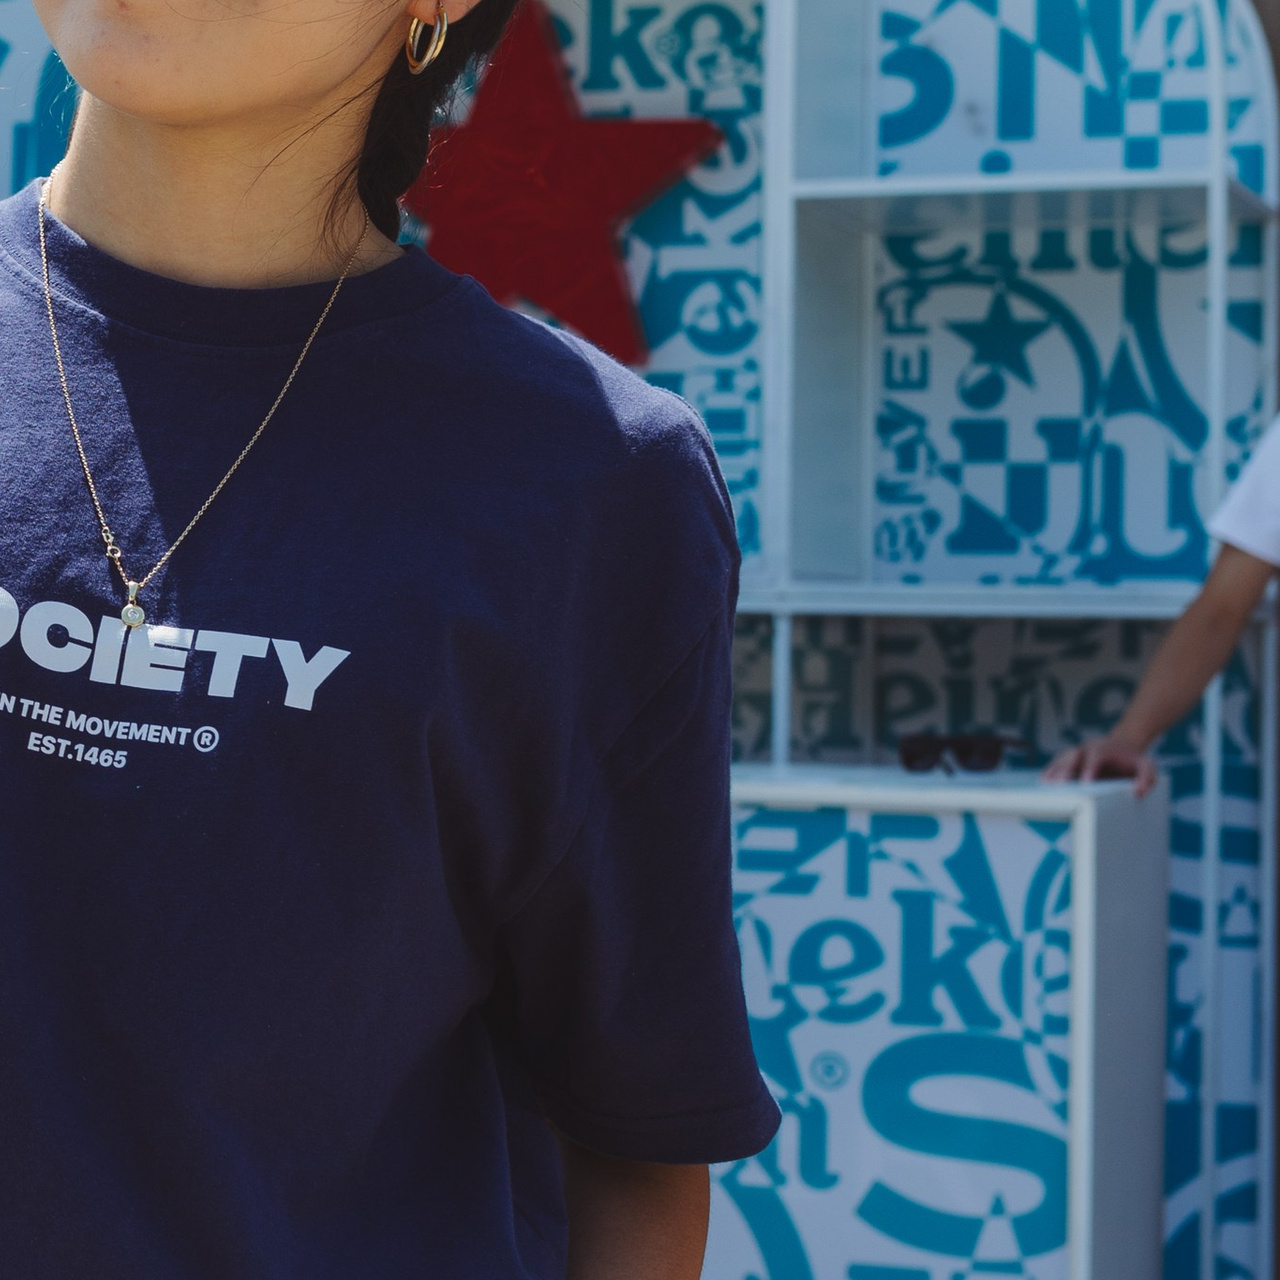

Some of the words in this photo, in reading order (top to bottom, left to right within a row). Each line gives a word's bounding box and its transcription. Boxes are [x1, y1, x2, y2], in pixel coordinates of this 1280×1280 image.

[20, 698, 64, 726] THE
[65, 710, 191, 746] MOVEMENT
[27, 731, 128, 769] EST.1465
